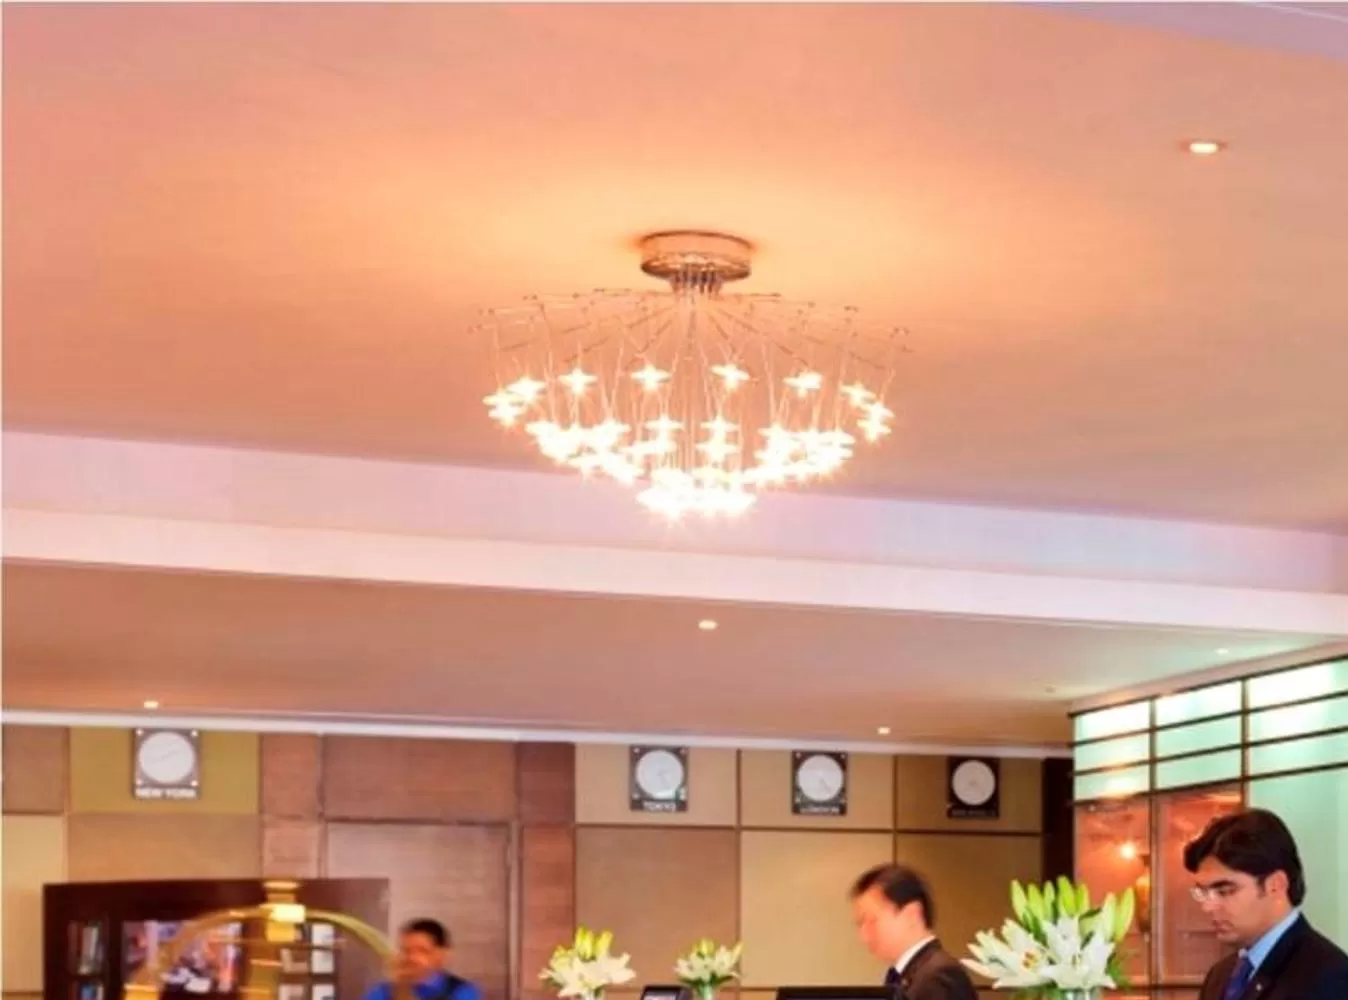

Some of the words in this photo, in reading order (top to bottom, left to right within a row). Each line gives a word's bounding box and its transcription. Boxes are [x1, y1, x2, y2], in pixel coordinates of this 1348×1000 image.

[135, 788, 161, 798] NEW
[166, 788, 196, 798] YORK
[643, 802, 676, 812] TOKYO
